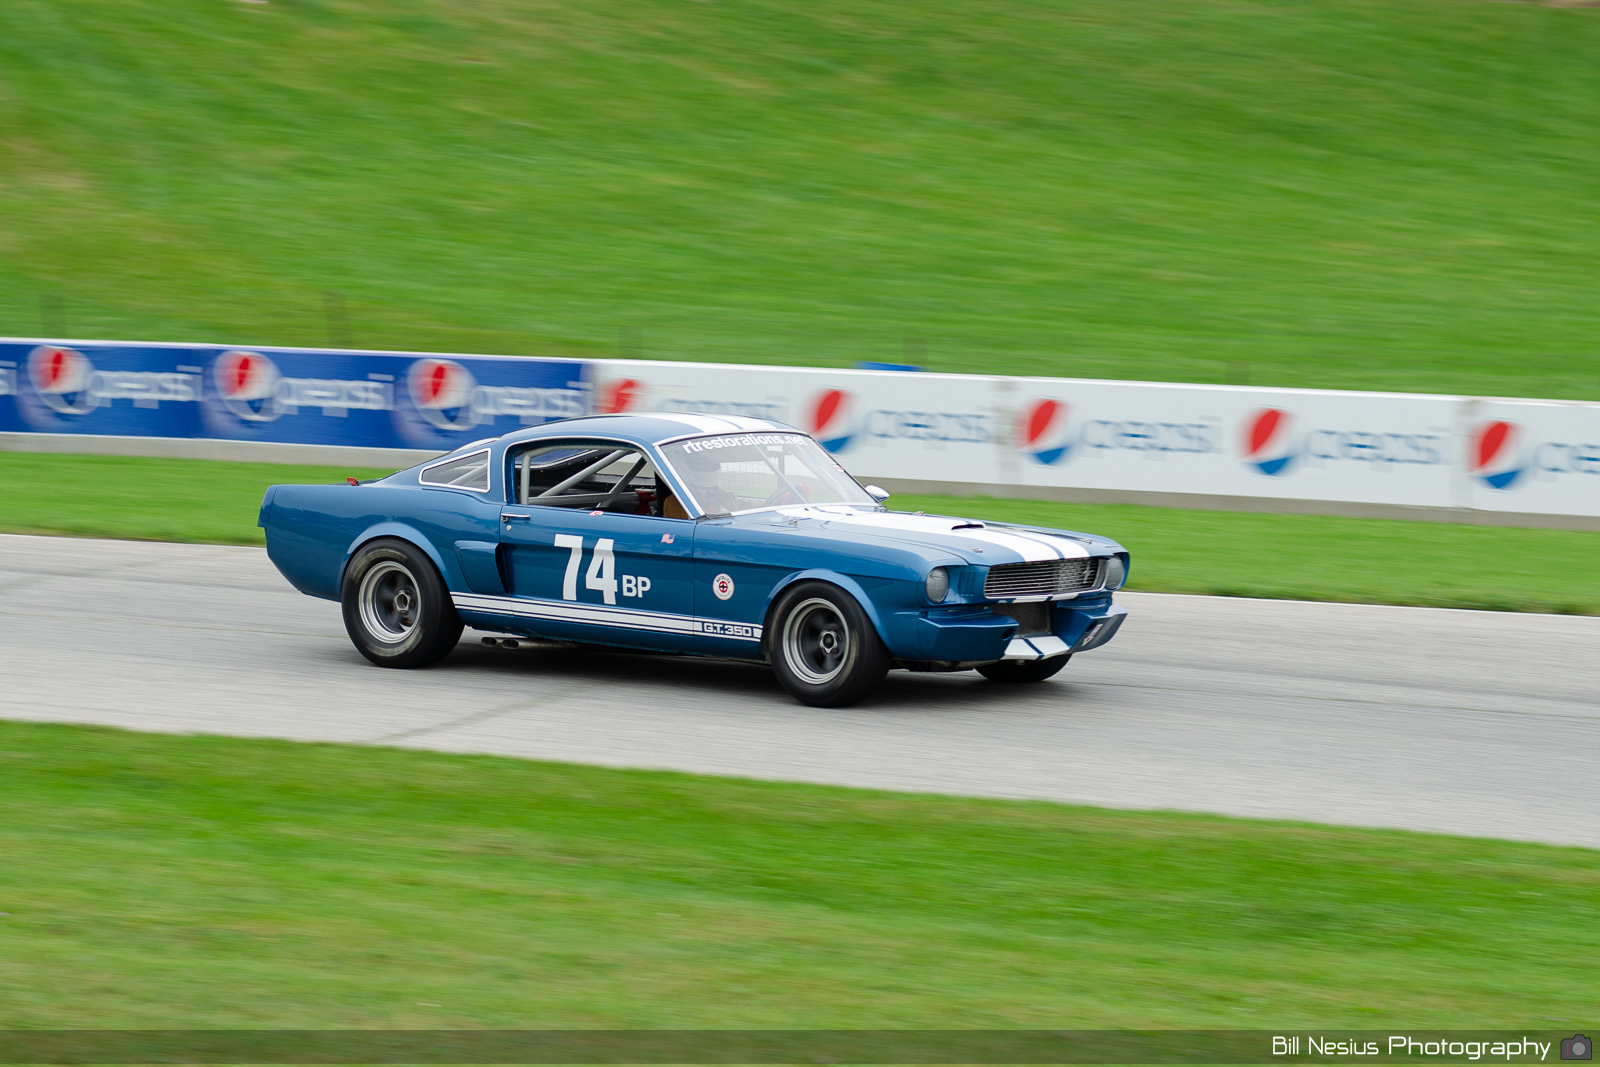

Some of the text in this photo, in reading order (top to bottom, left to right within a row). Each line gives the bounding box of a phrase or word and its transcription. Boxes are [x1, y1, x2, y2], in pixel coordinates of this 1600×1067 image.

[682, 434, 808, 454] rtrestorations.net
[554, 534, 651, 605] 74 BP
[703, 622, 752, 637] G.T.350
